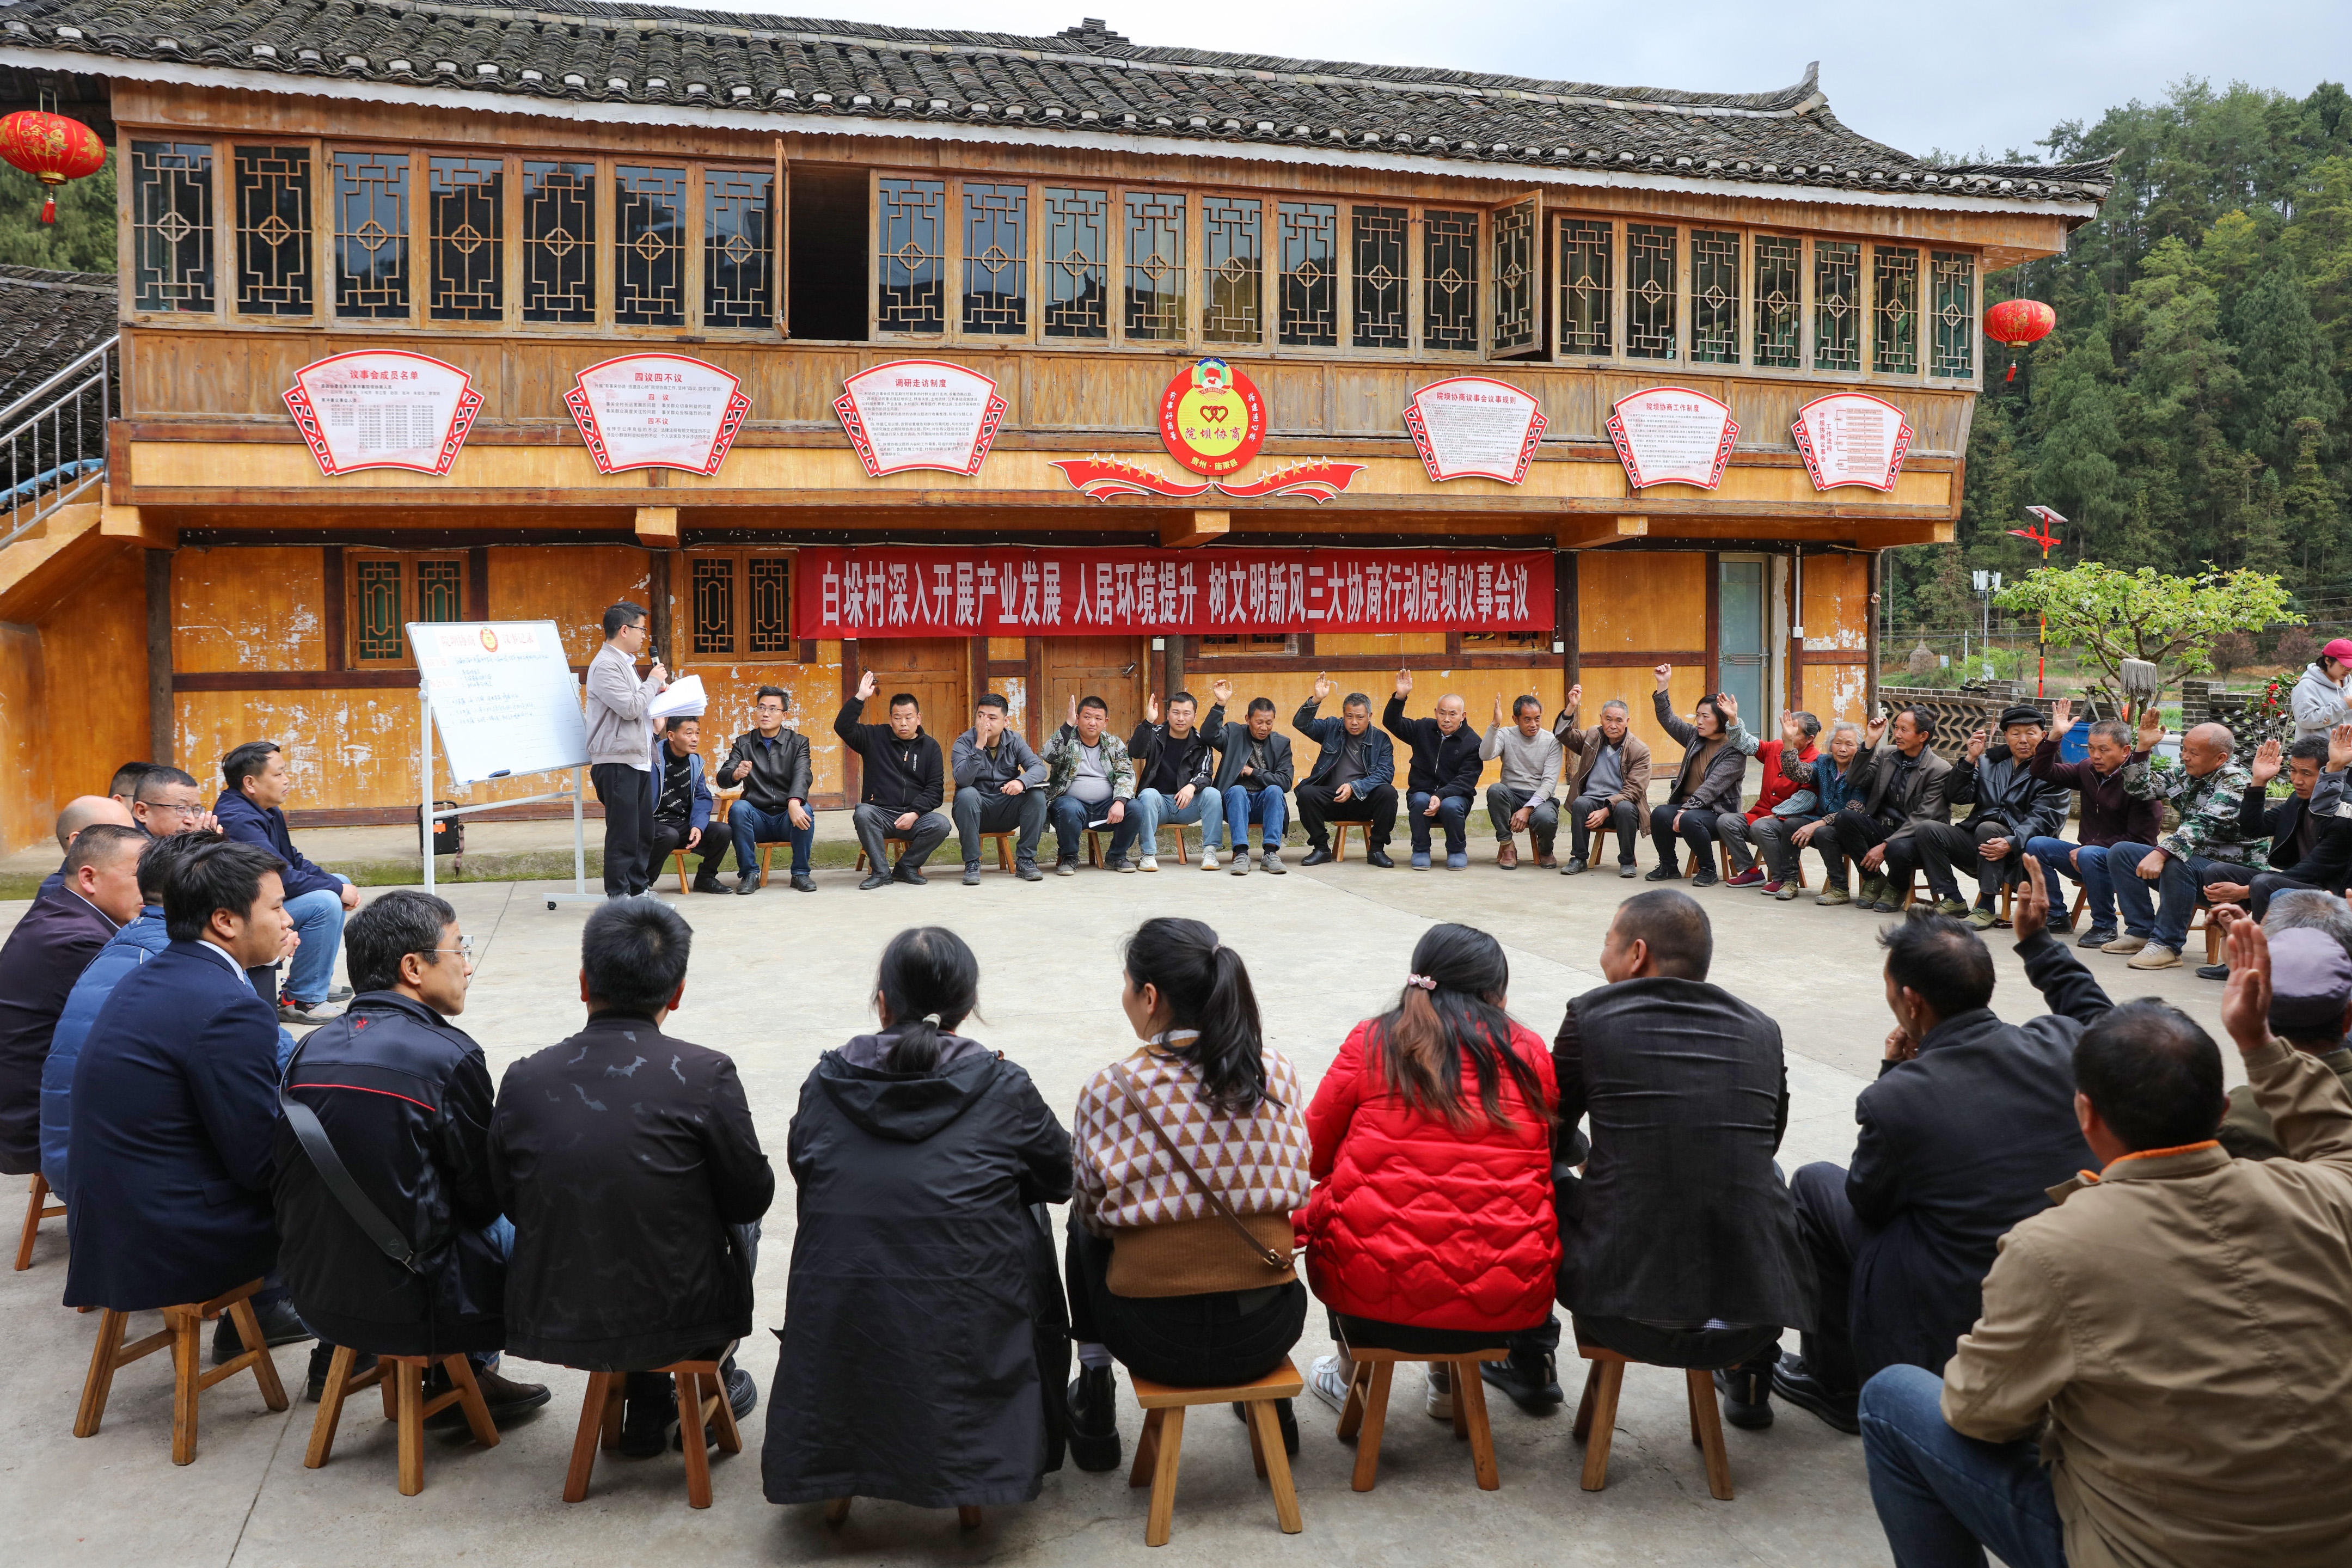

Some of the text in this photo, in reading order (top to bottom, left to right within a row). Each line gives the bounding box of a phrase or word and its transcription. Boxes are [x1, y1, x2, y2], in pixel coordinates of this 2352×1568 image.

[350, 370, 419, 381] 议事会成员名单
[635, 373, 683, 383] 四议四不议
[896, 379, 946, 388] 调研走访制度
[1436, 392, 1516, 404] 院坝协商议事会议事规则
[1646, 403, 1699, 412] 院坝协商工作制度
[1165, 391, 1177, 441] 有事好商量
[1185, 427, 1240, 442] 院坝协商
[822, 560, 1529, 627] 白垛村深入开展产业发展 人居环境提升 树文明新风三大协商行动院坝议事会议
